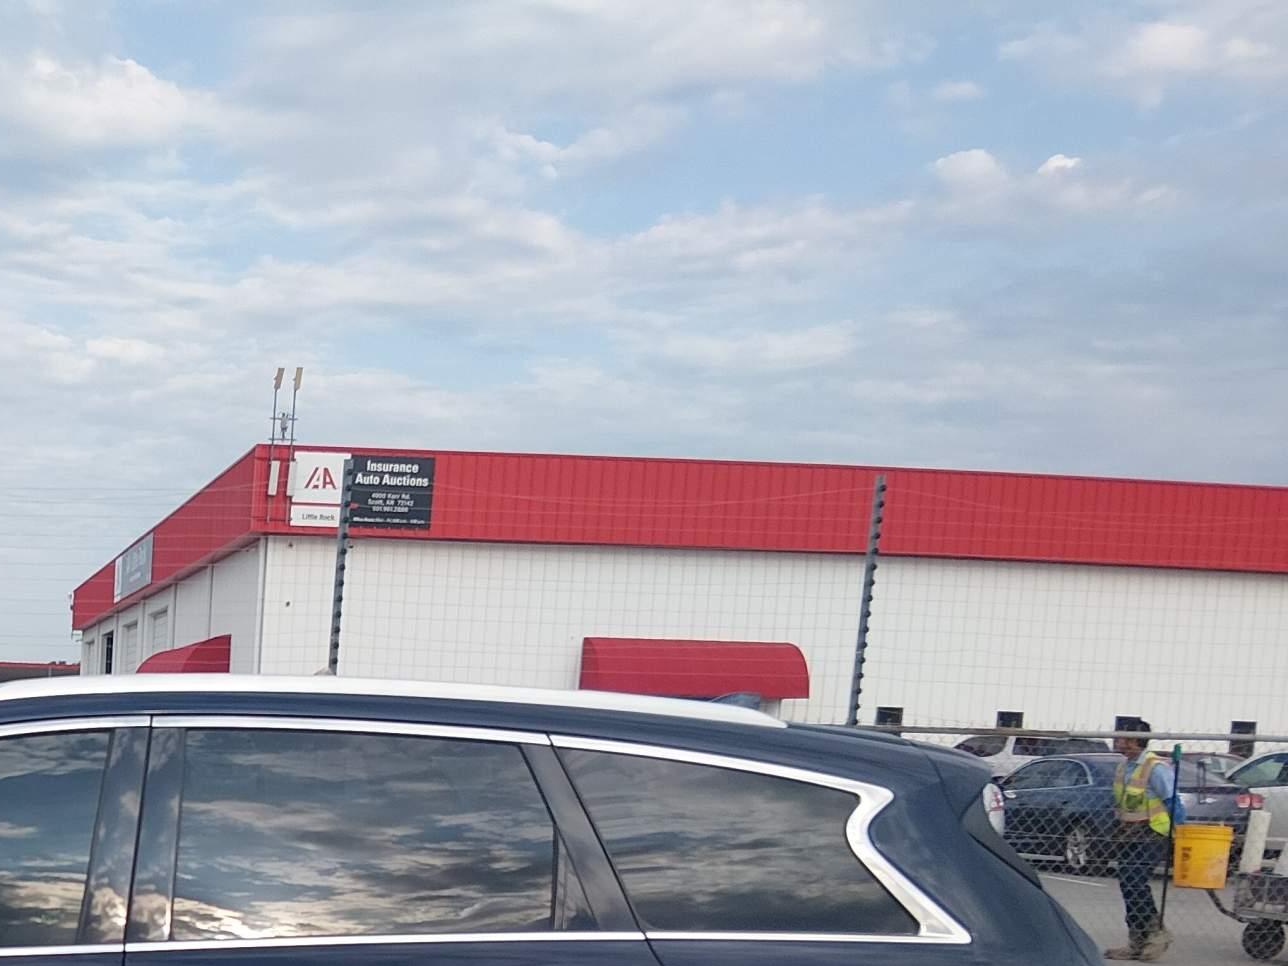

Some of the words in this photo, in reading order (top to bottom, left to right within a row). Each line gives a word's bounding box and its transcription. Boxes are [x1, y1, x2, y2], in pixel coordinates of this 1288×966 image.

[367, 459, 419, 473] Insurance
[355, 472, 380, 485] Auto
[382, 473, 429, 487] Auctions
[302, 513, 317, 521] Little
[319, 513, 335, 521] Rock
